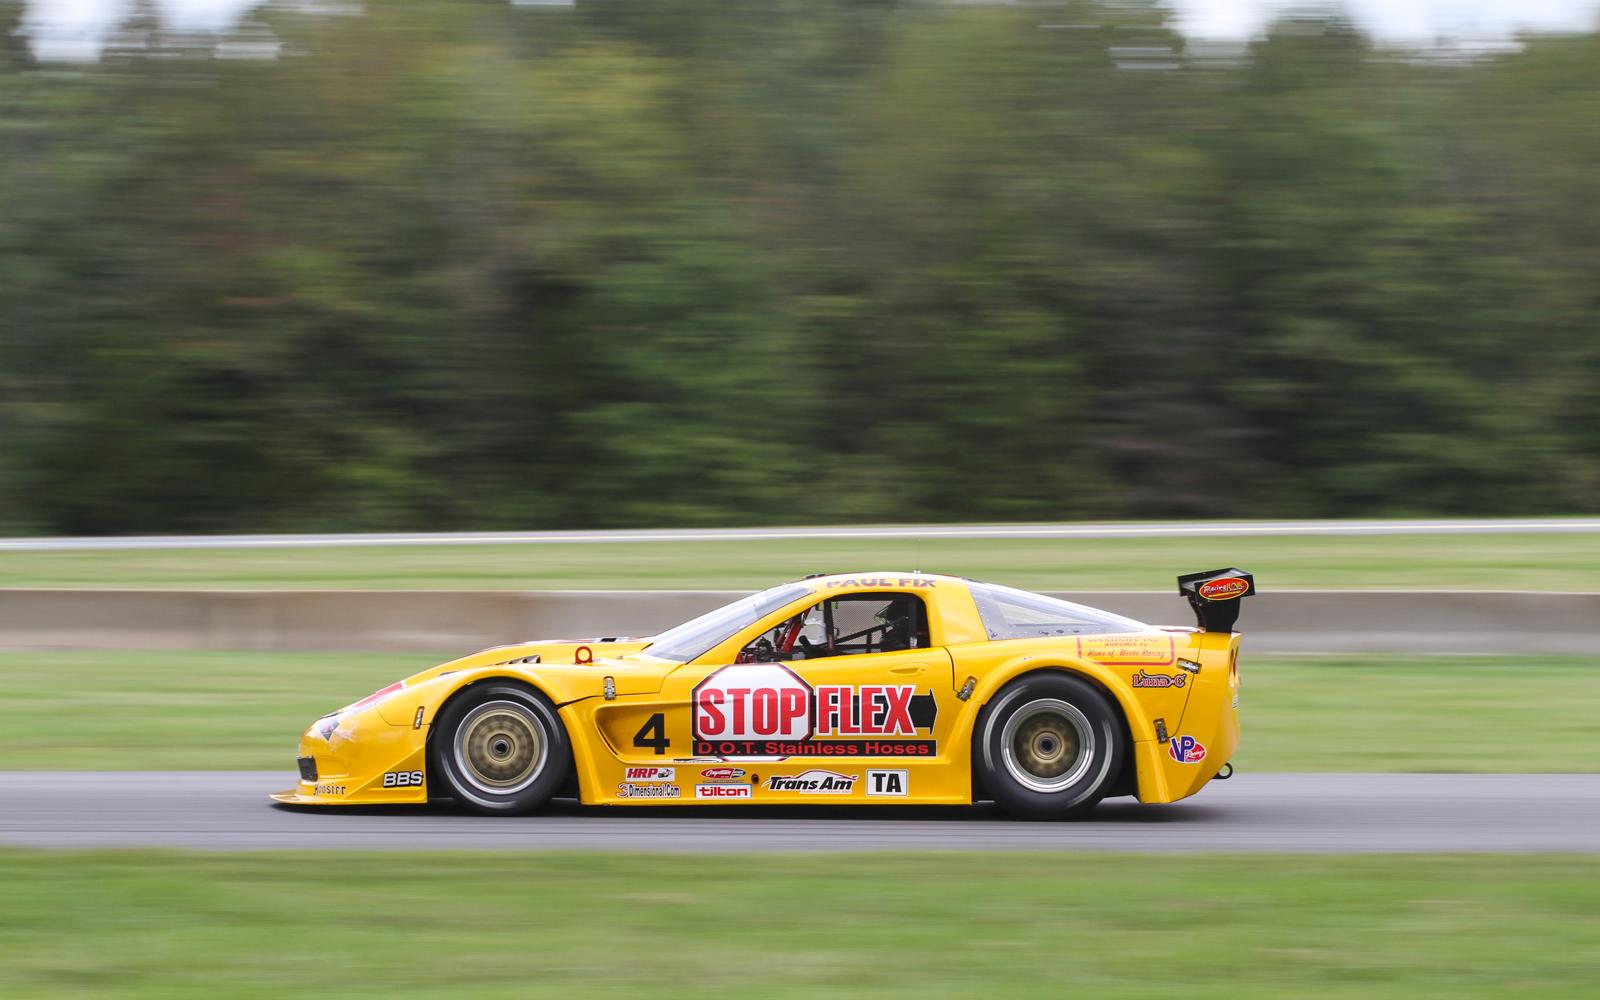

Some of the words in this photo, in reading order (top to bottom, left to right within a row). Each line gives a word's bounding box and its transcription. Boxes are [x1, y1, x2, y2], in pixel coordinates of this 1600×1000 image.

[826, 578, 893, 588] PAUL
[898, 578, 936, 588] FIX
[699, 687, 807, 736] STOP
[817, 686, 917, 735] FLEX
[633, 713, 670, 755] 4
[698, 742, 758, 755] D.O.T.
[765, 742, 858, 755] Stainless
[865, 742, 929, 755] Hoses
[1170, 735, 1195, 763] VP
[383, 770, 423, 788] BBS
[626, 768, 659, 778] HRP
[698, 786, 748, 797] tilton
[768, 776, 818, 790] Trans
[819, 776, 853, 790] Am
[872, 773, 902, 793] TA
